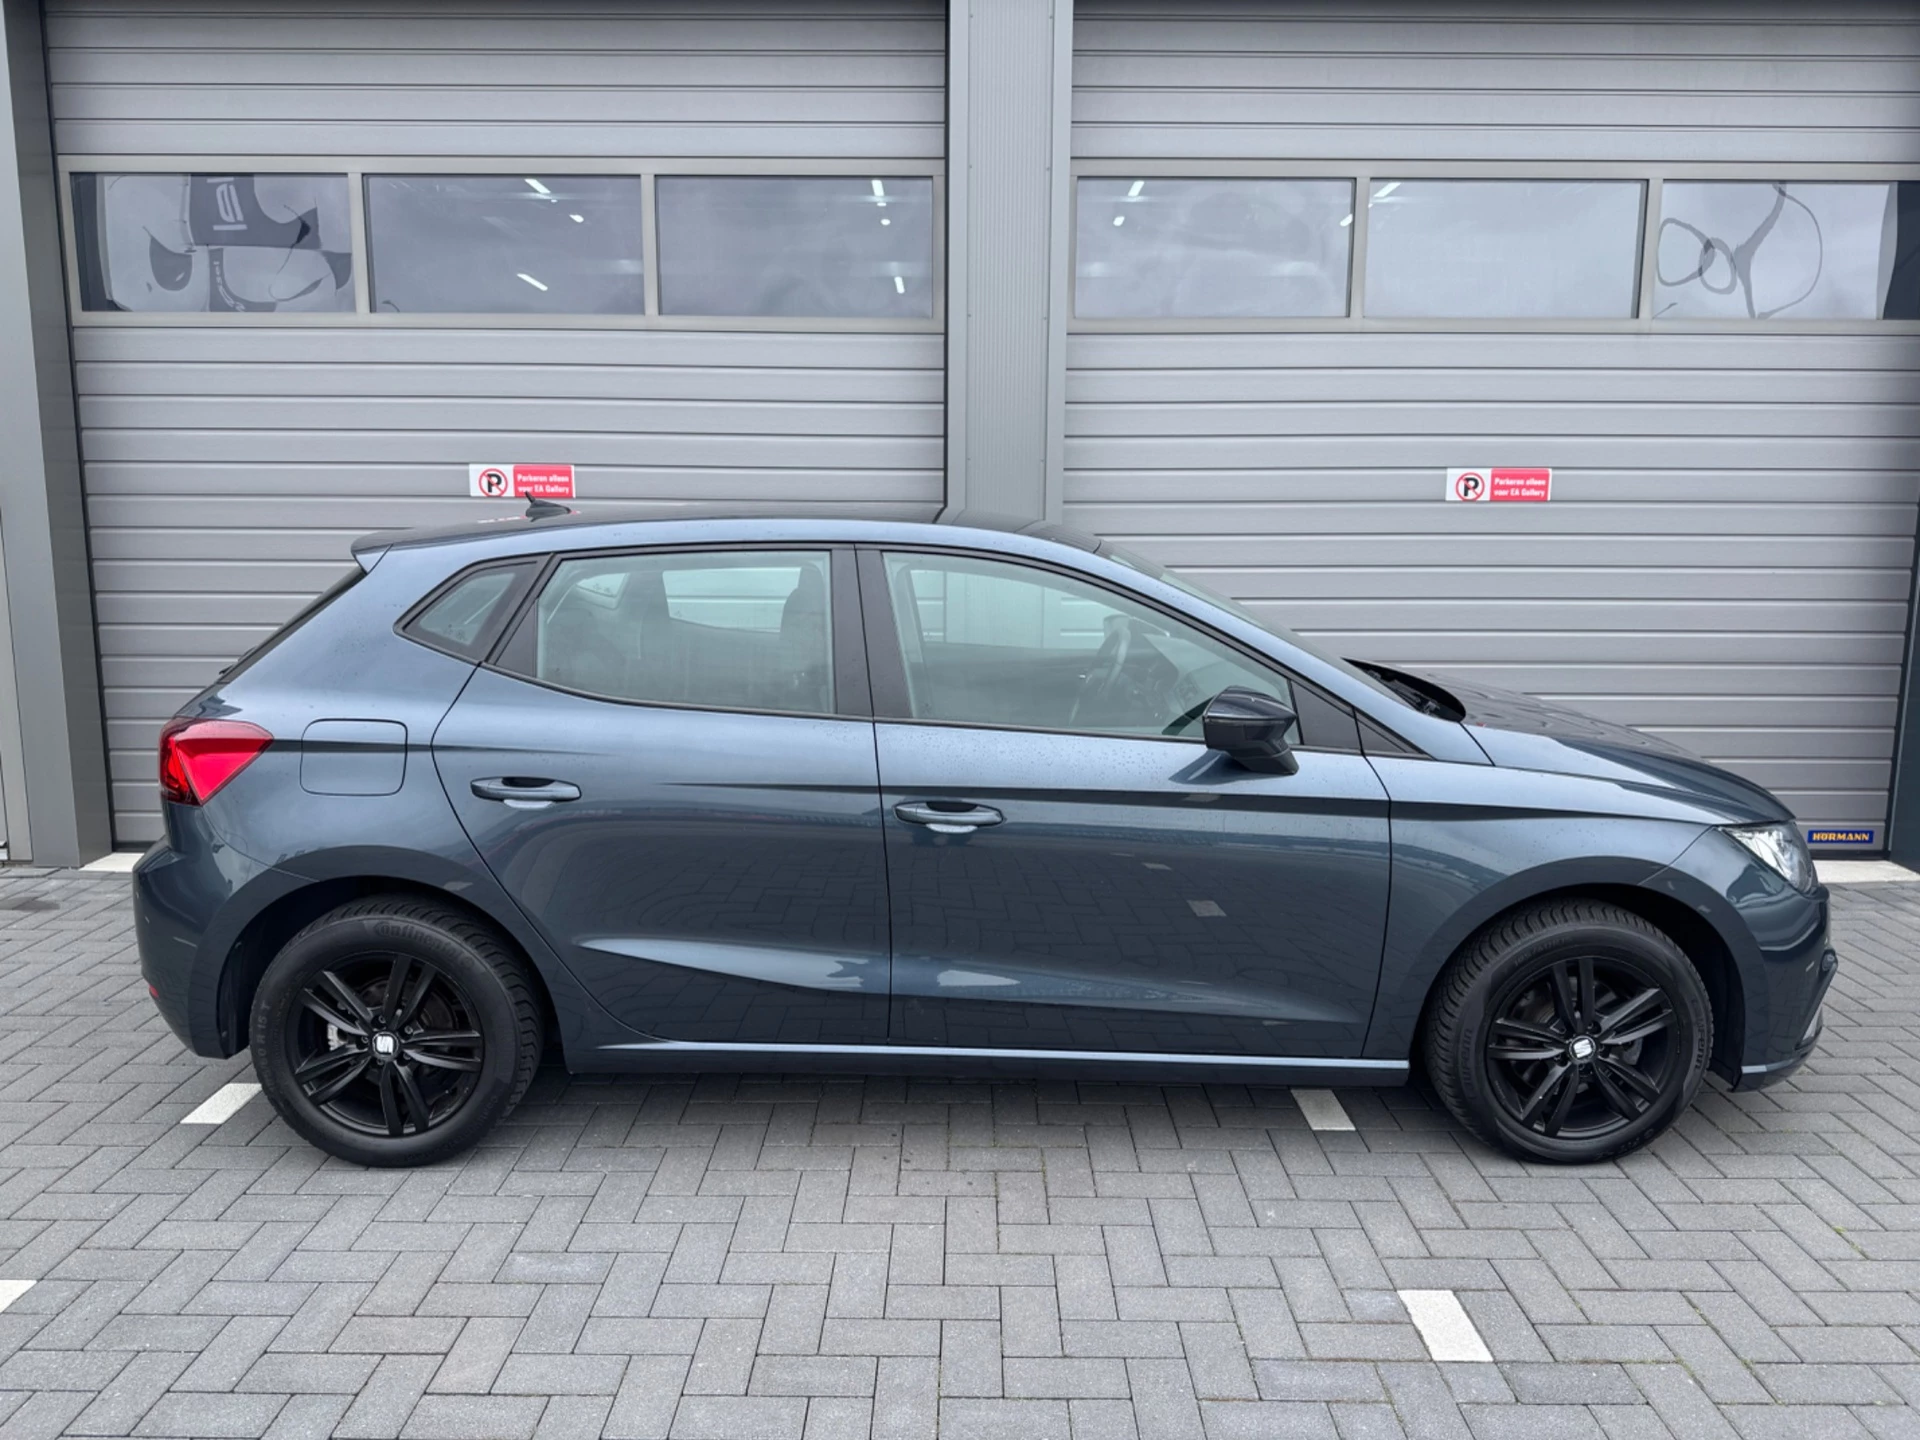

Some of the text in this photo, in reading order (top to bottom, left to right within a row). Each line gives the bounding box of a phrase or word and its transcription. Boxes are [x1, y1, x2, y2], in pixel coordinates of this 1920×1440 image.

[517, 474, 570, 483] Parkeren alleen
[1494, 478, 1546, 486] Parkeren alleen
[534, 485, 544, 493] EA
[546, 486, 570, 495] Gallery
[1510, 488, 1520, 496] EA
[1522, 488, 1545, 498] Gallery
